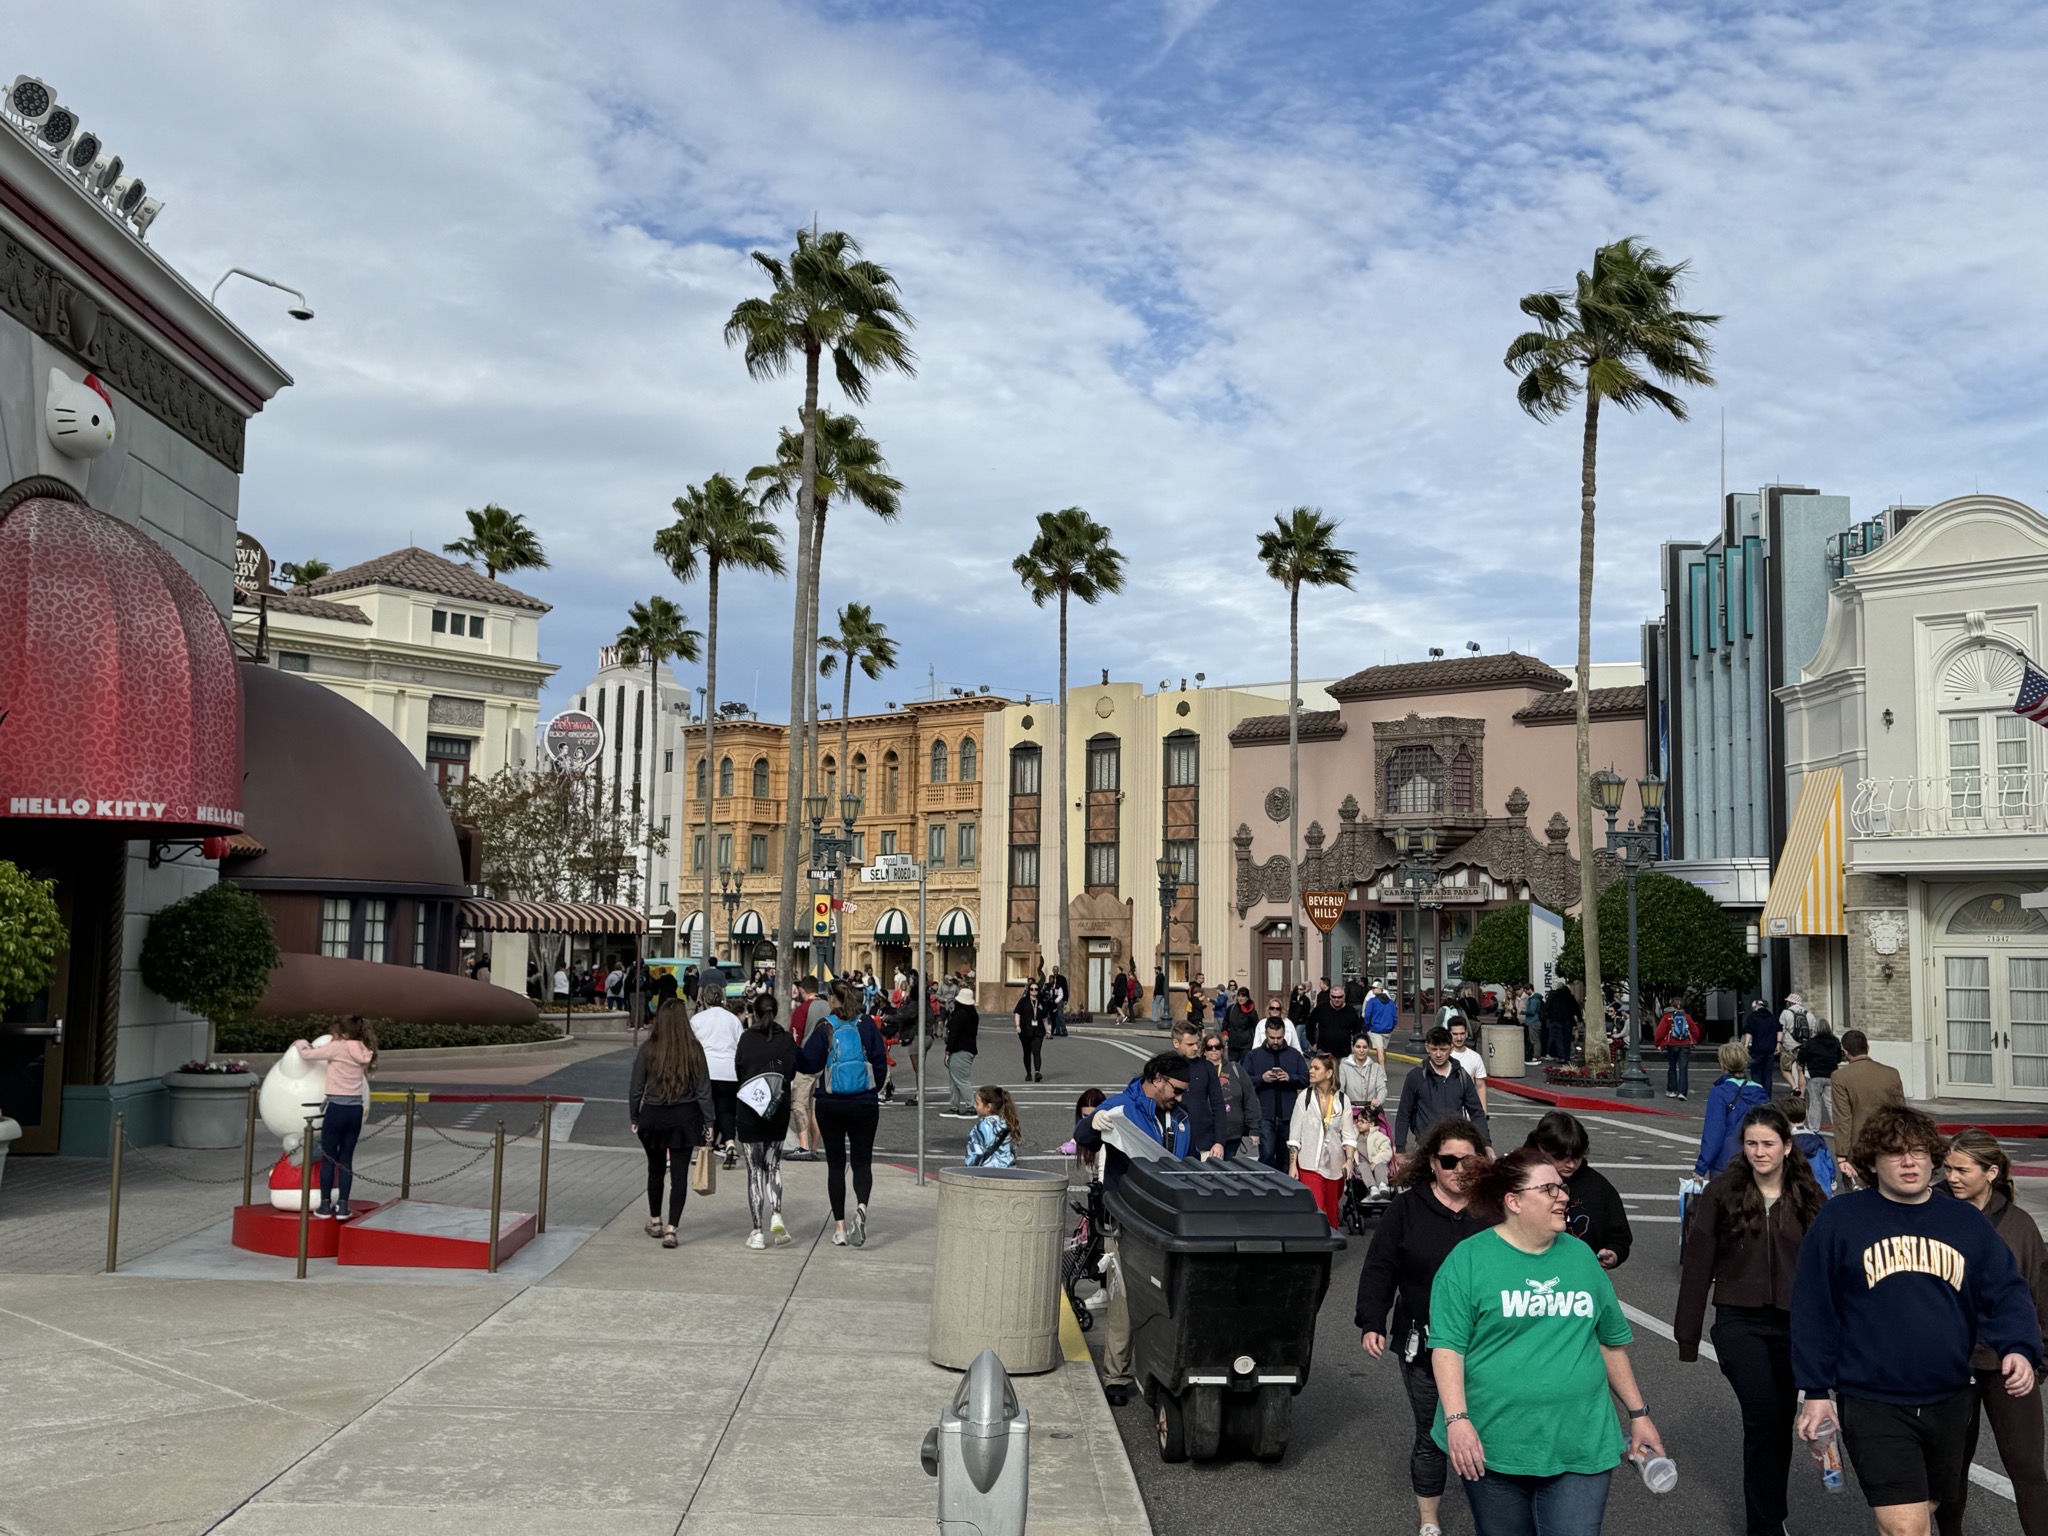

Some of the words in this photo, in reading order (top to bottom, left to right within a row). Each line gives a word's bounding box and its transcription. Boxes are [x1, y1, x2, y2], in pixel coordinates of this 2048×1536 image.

[10, 797, 90, 816] HELLO
[96, 800, 167, 819] KITTY
[197, 805, 232, 825] HELLO
[811, 870, 824, 879] IVAR
[893, 867, 911, 880] RODEO
[841, 901, 858, 914] STOP
[1308, 896, 1343, 906] BEVERLY
[1314, 908, 1338, 918] HILLS
[1863, 1235, 1965, 1293] SALESIANUM
[1501, 1289, 1594, 1318] Wawa
